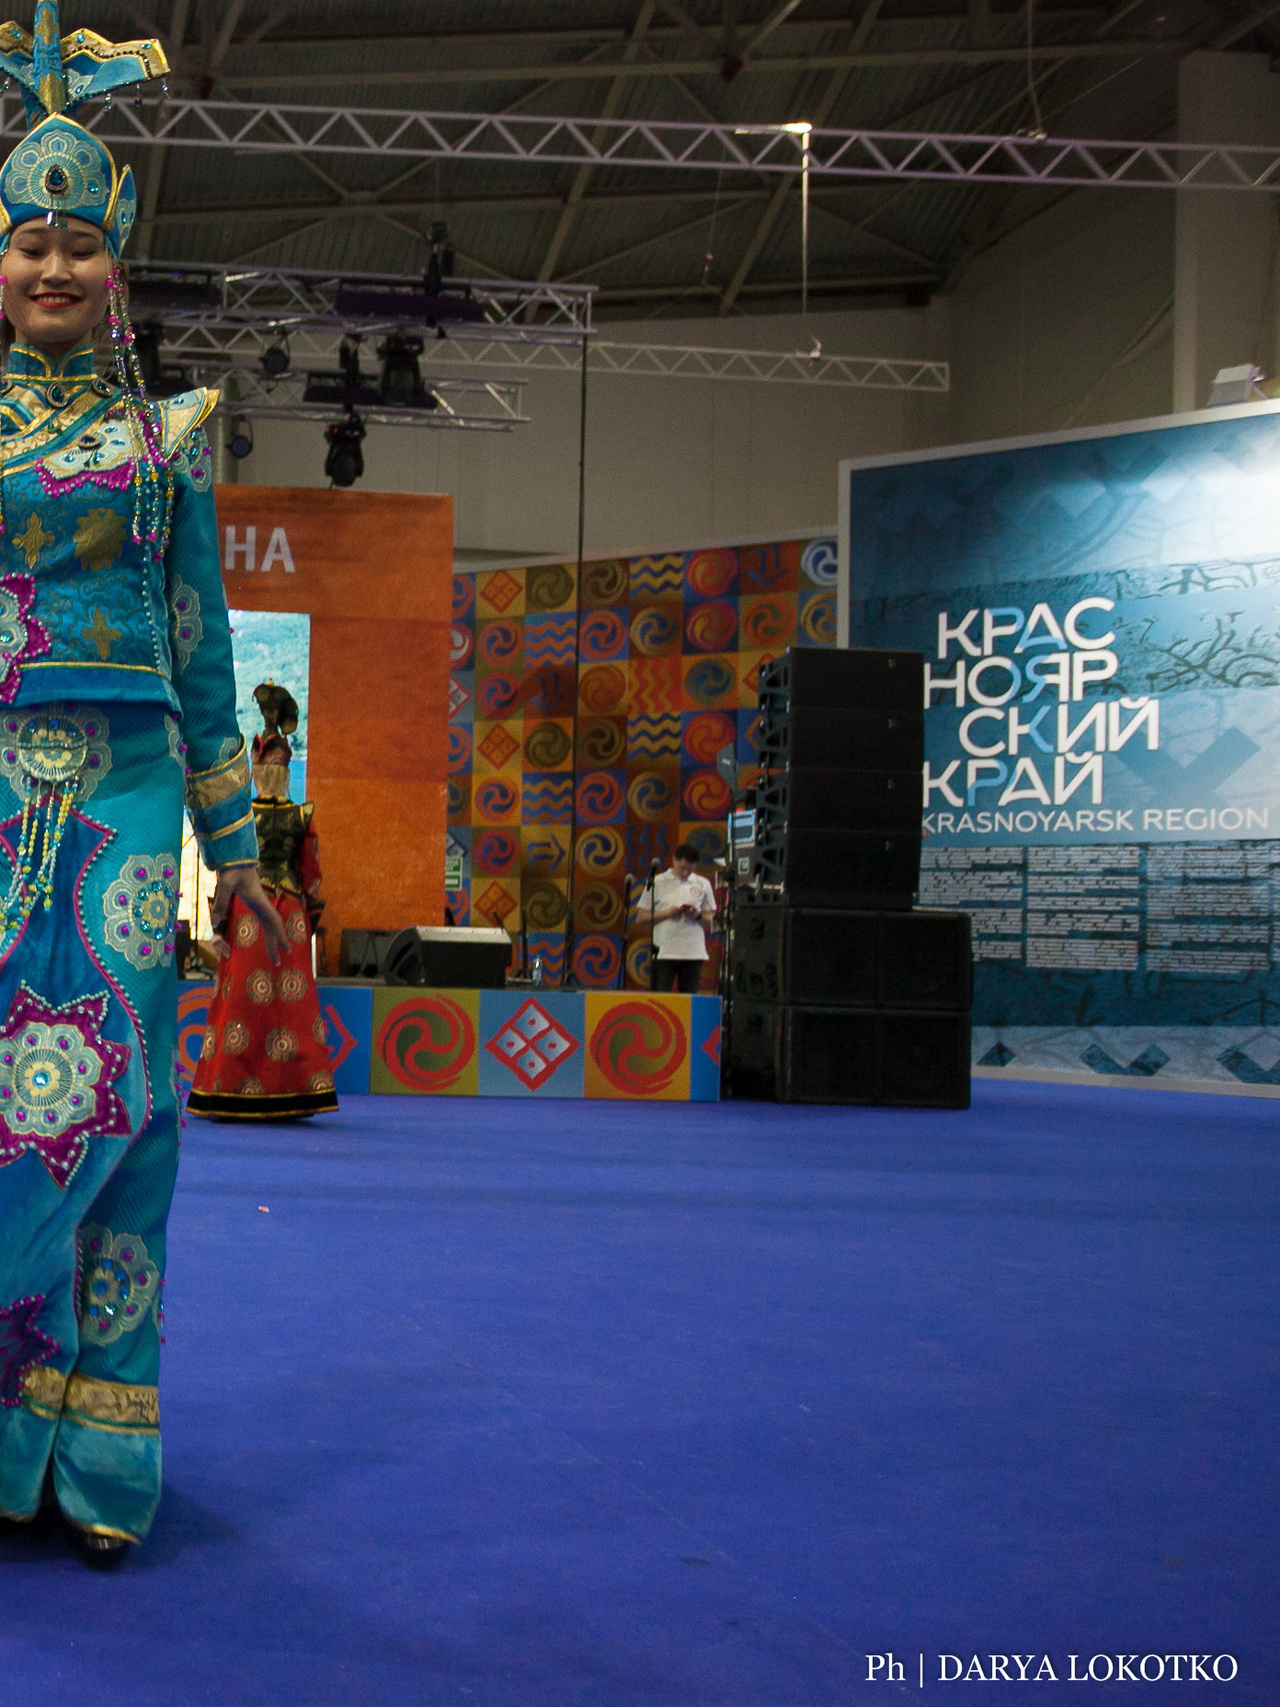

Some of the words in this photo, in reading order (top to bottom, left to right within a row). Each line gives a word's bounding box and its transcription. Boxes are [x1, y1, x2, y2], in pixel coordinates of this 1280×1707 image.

[937, 596, 1116, 660] КРАС
[923, 649, 1119, 710] НОЯР
[958, 695, 1160, 758] СКИЙ
[922, 750, 1103, 808] КРАЙ
[922, 808, 1135, 834] KRASNOYARSK
[1143, 806, 1270, 831] REGION
